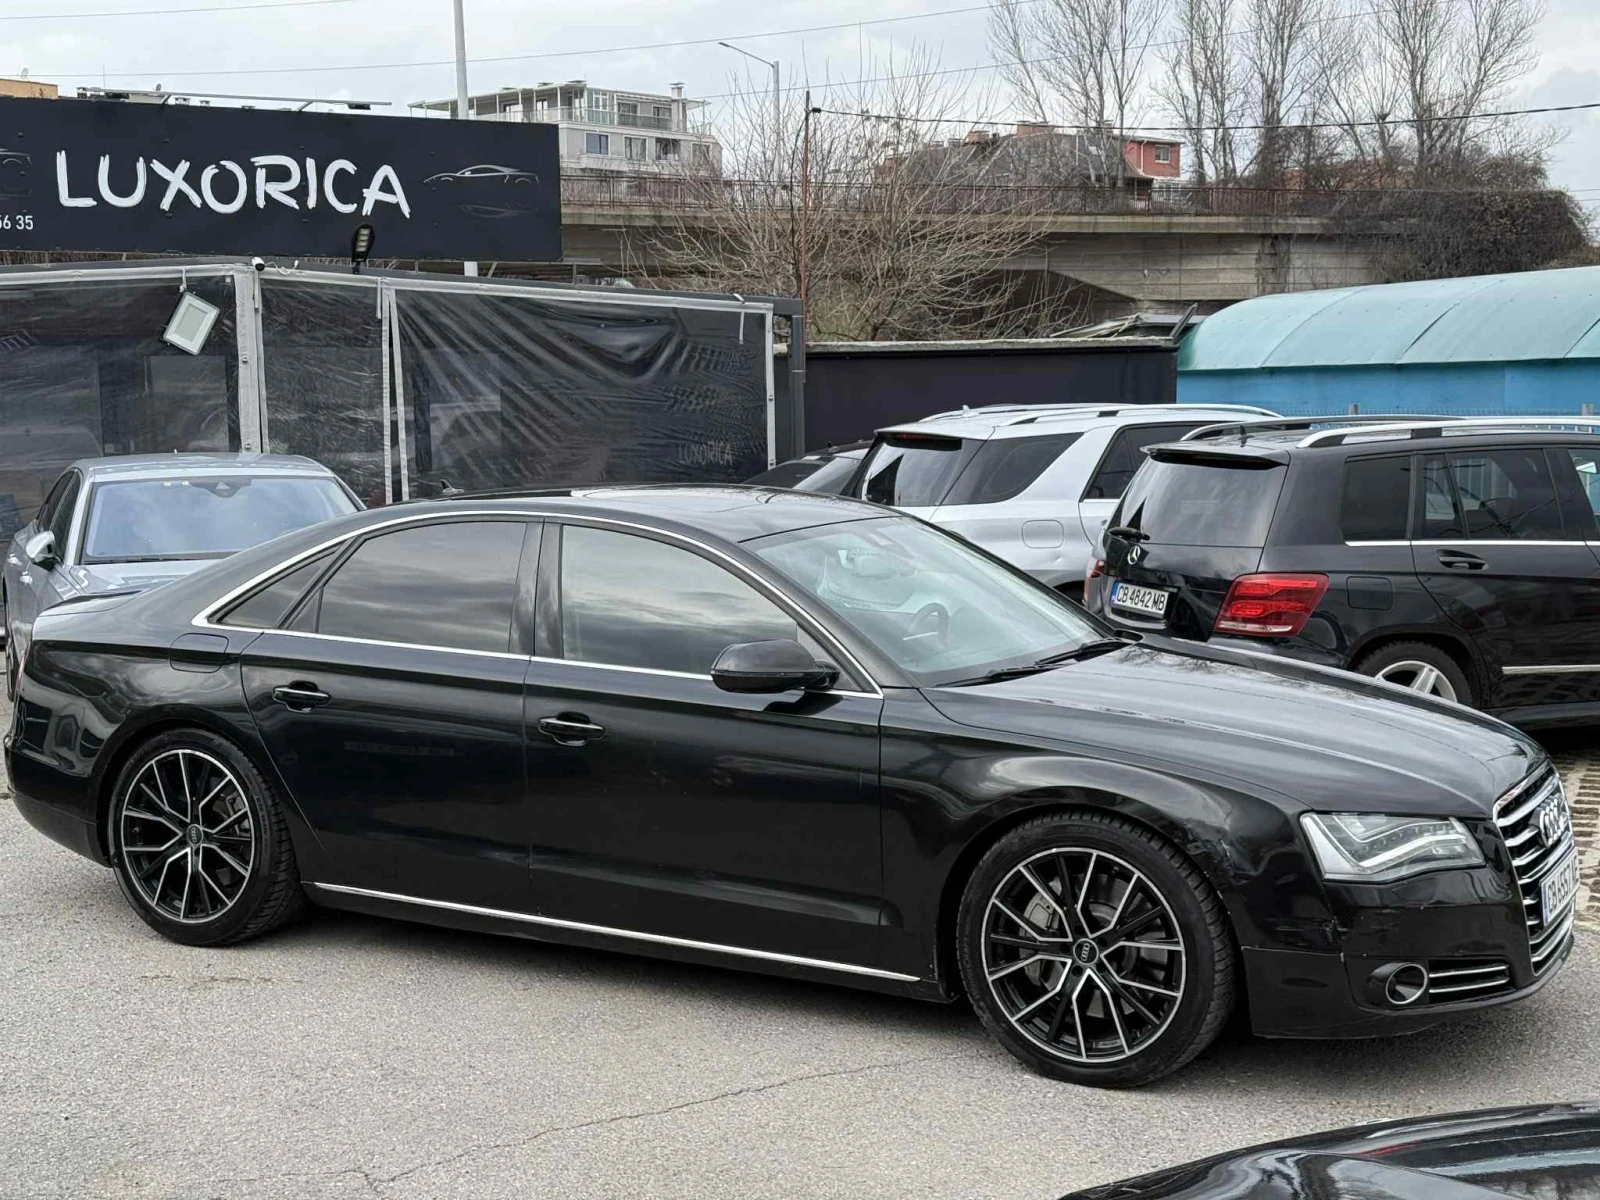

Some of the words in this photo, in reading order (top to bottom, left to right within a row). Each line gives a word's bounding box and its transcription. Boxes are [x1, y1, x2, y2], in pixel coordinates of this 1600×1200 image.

[56, 150, 410, 218] LUXORICA
[16, 215, 34, 230] 35
[678, 440, 733, 466] LUXORICA
[1116, 585, 1129, 604] CB
[1129, 588, 1152, 608] 4842
[1151, 595, 1167, 611] MB
